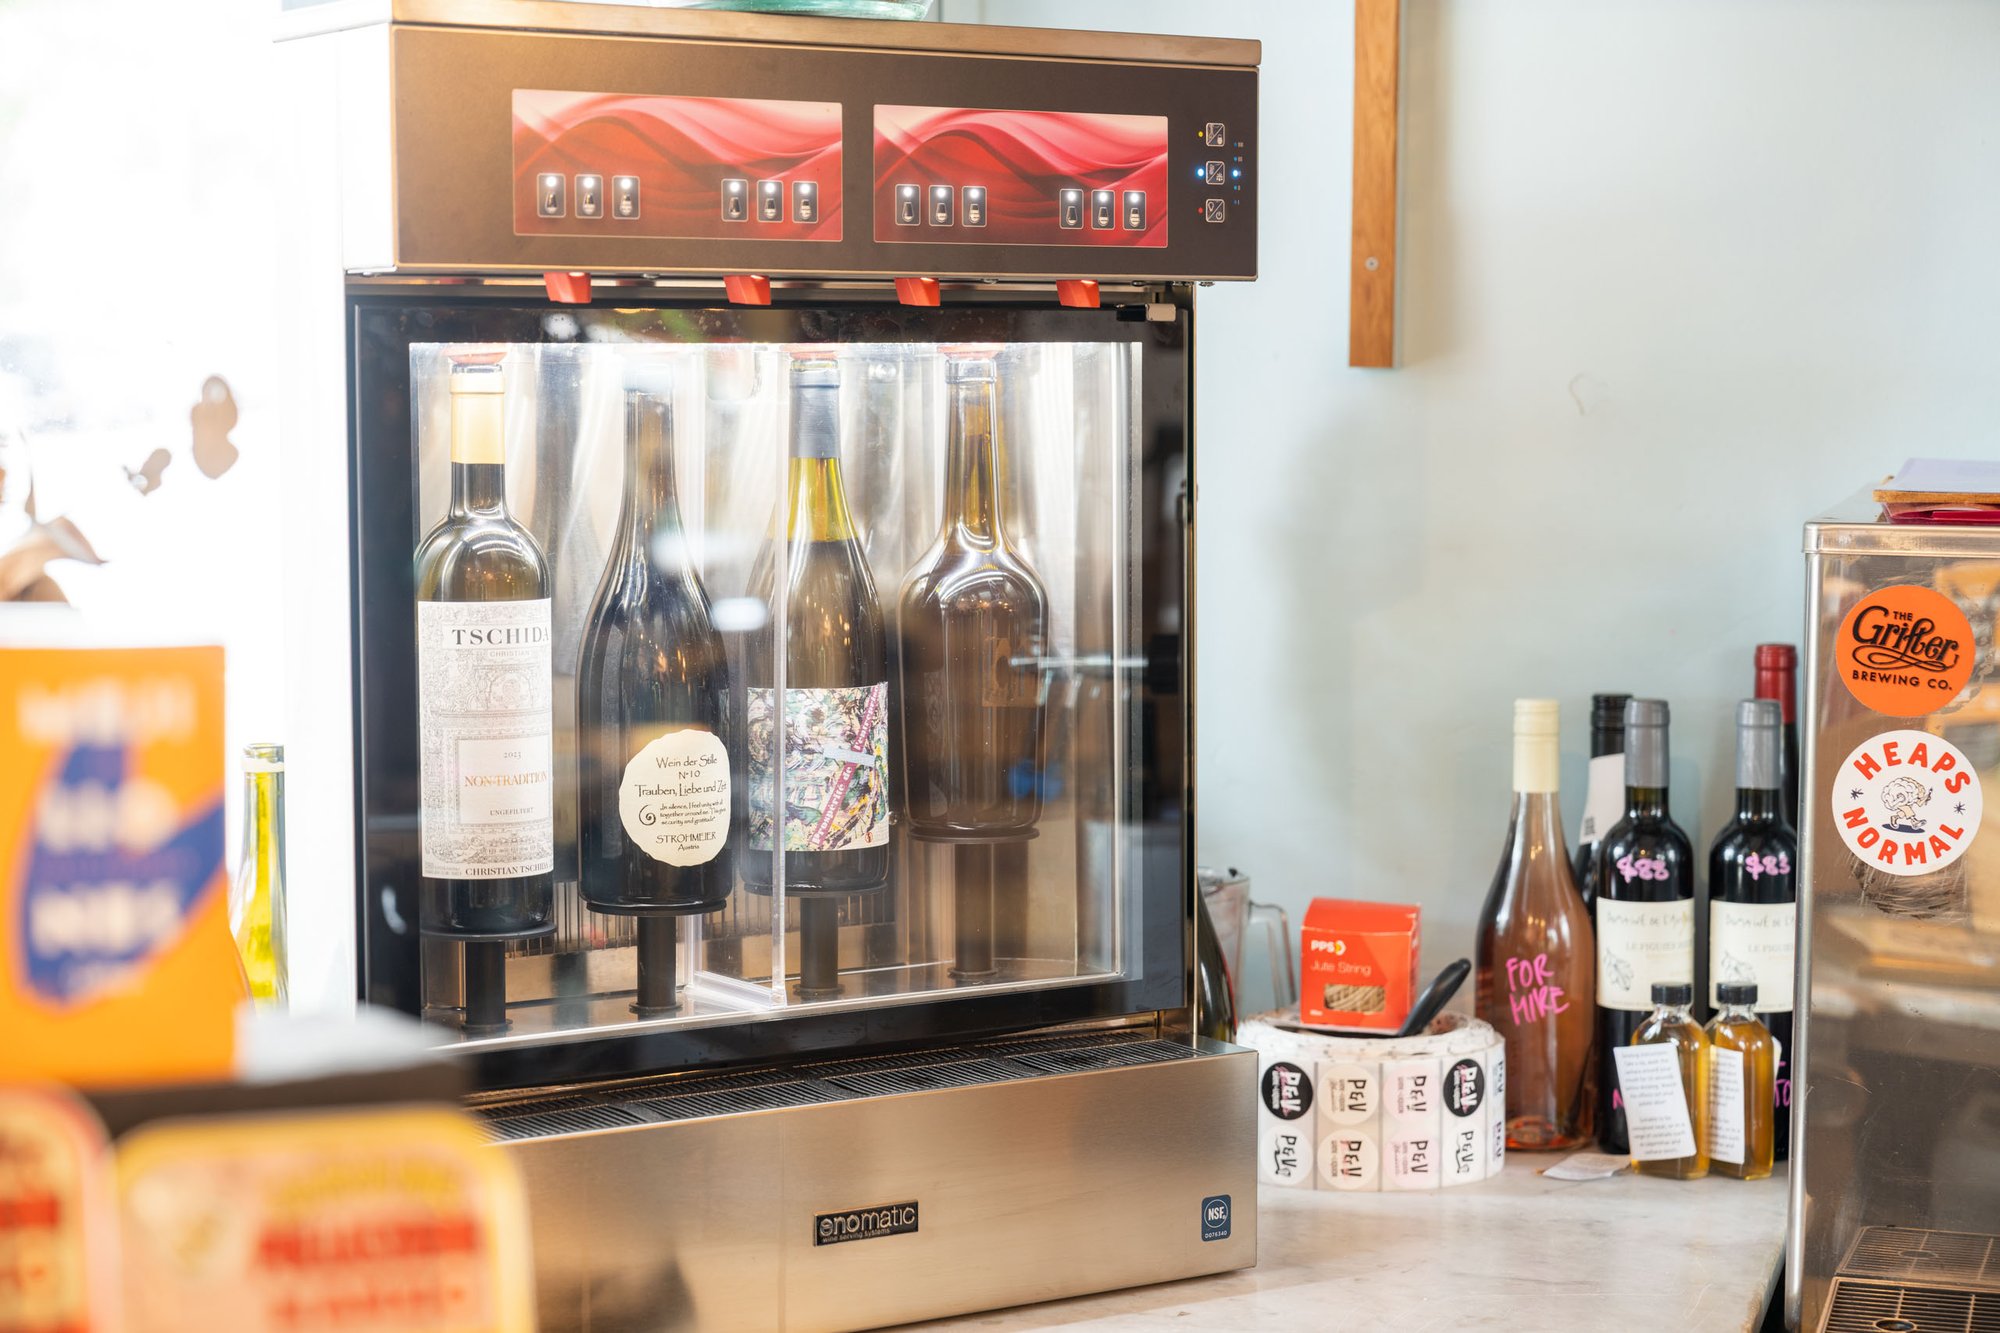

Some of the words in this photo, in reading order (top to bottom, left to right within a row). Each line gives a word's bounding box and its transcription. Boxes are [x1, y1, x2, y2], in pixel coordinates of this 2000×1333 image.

[1892, 611, 1913, 621] THE
[451, 626, 549, 645] TSCHIDA
[1852, 605, 1959, 672] Grifter
[1852, 669, 1920, 687] BREWING
[1927, 678, 1953, 691] CO.
[656, 756, 681, 768] Wein
[683, 755, 698, 767] der
[1853, 741, 1971, 794] HEAPS
[464, 770, 548, 787] NON-TRADITION
[634, 784, 678, 797] Trauben,
[679, 782, 702, 796] Liebe
[703, 781, 717, 792] und
[656, 832, 717, 843] STROHMEIER
[1843, 807, 1965, 865] NORMAL
[465, 866, 518, 876] CHRISTIAN
[520, 862, 549, 873] TSCHIDA
[1310, 960, 1335, 972] Jute
[1338, 961, 1372, 977] String
[1505, 953, 1554, 992] FOR
[1280, 1071, 1302, 1111] P&V
[1347, 1079, 1367, 1112] P&V
[1406, 1075, 1427, 1112] P&V
[1460, 1066, 1478, 1106] P&V
[1281, 1135, 1297, 1168] P&V
[1340, 1140, 1362, 1177] P&V
[1410, 1140, 1428, 1173] P&V
[1461, 1130, 1474, 1162] P&V
[820, 1206, 915, 1237] enomatic
[1208, 1206, 1225, 1221] NSF
[822, 1235, 838, 1243] wine
[839, 1232, 863, 1240] serving
[864, 1228, 891, 1239] systems
